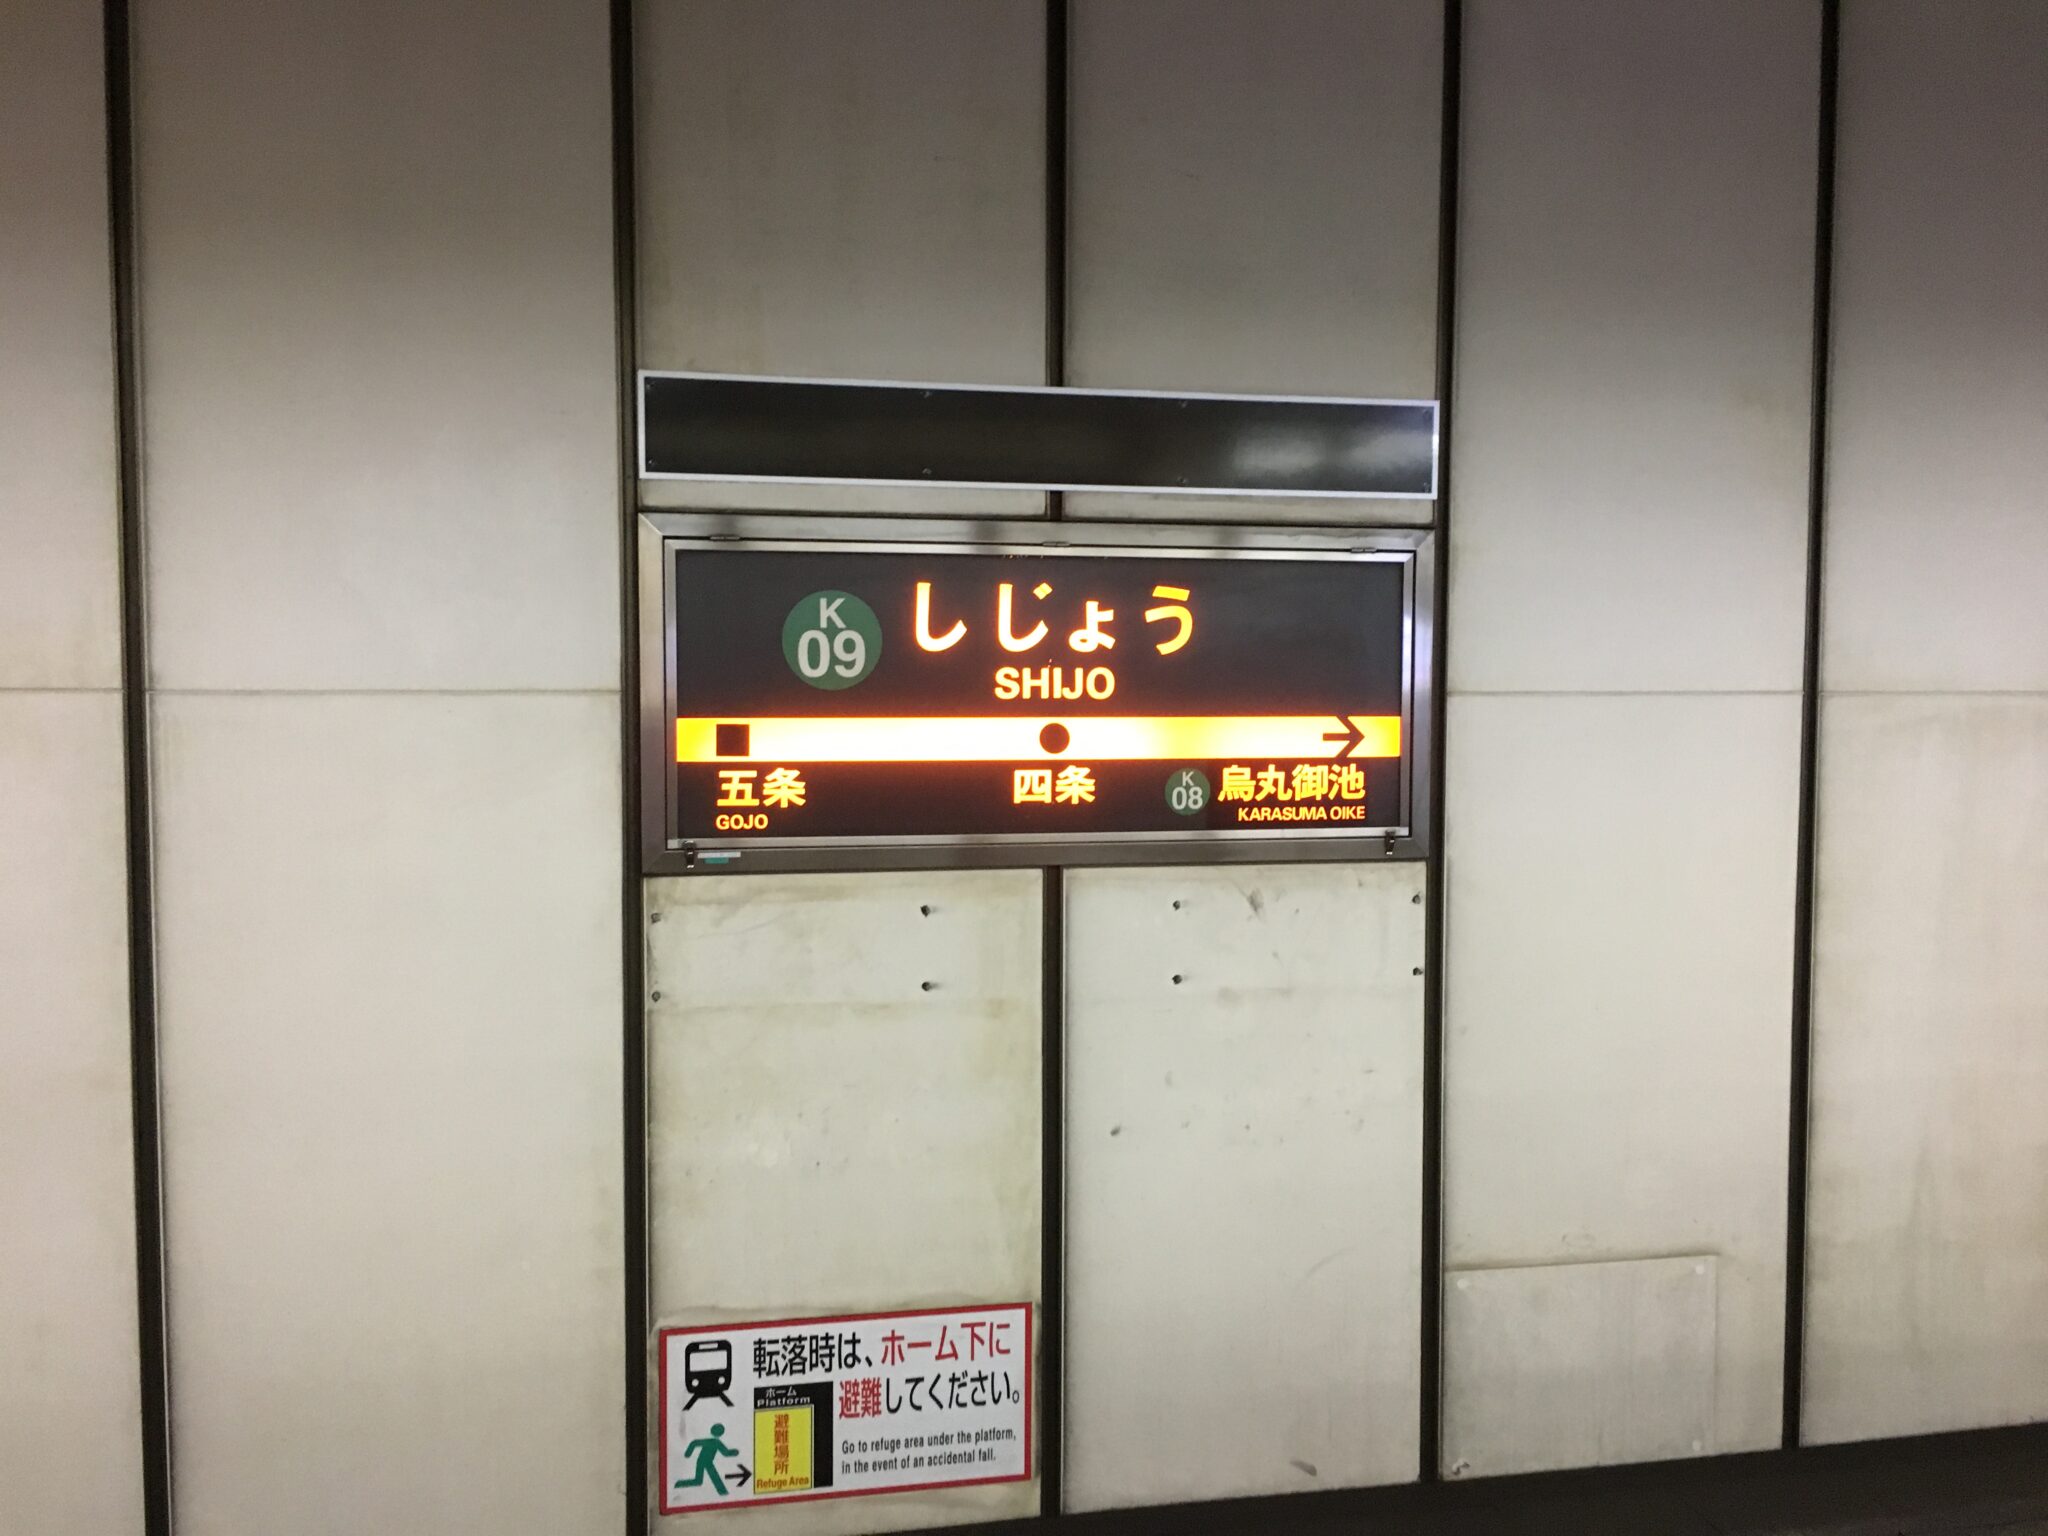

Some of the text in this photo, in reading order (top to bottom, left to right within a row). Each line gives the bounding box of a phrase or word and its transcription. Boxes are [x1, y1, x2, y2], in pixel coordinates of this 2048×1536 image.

[819, 597, 847, 629] K
[913, 580, 1196, 656] しじょう
[796, 629, 867, 679] 09
[993, 666, 1116, 701] SHIJO
[715, 768, 807, 809] 五条
[1011, 765, 1097, 805] 四条
[1181, 771, 1195, 787] K
[1217, 763, 1366, 802] 烏丸御池
[1171, 786, 1204, 810] 08
[715, 813, 769, 831] GOJO
[1237, 805, 1366, 822] KARASUMA OIKE
[752, 1321, 1012, 1379] 転落時は、ホーム下に
[756, 1396, 811, 1408] Platform
[765, 1386, 797, 1398] ホーム
[838, 1369, 1021, 1420] 避難してください。
[841, 1426, 1017, 1454] Go to refuge area under the platform,
[841, 1447, 996, 1475] in the event of an accidental fall.
[756, 1476, 810, 1490] Refuge Area
